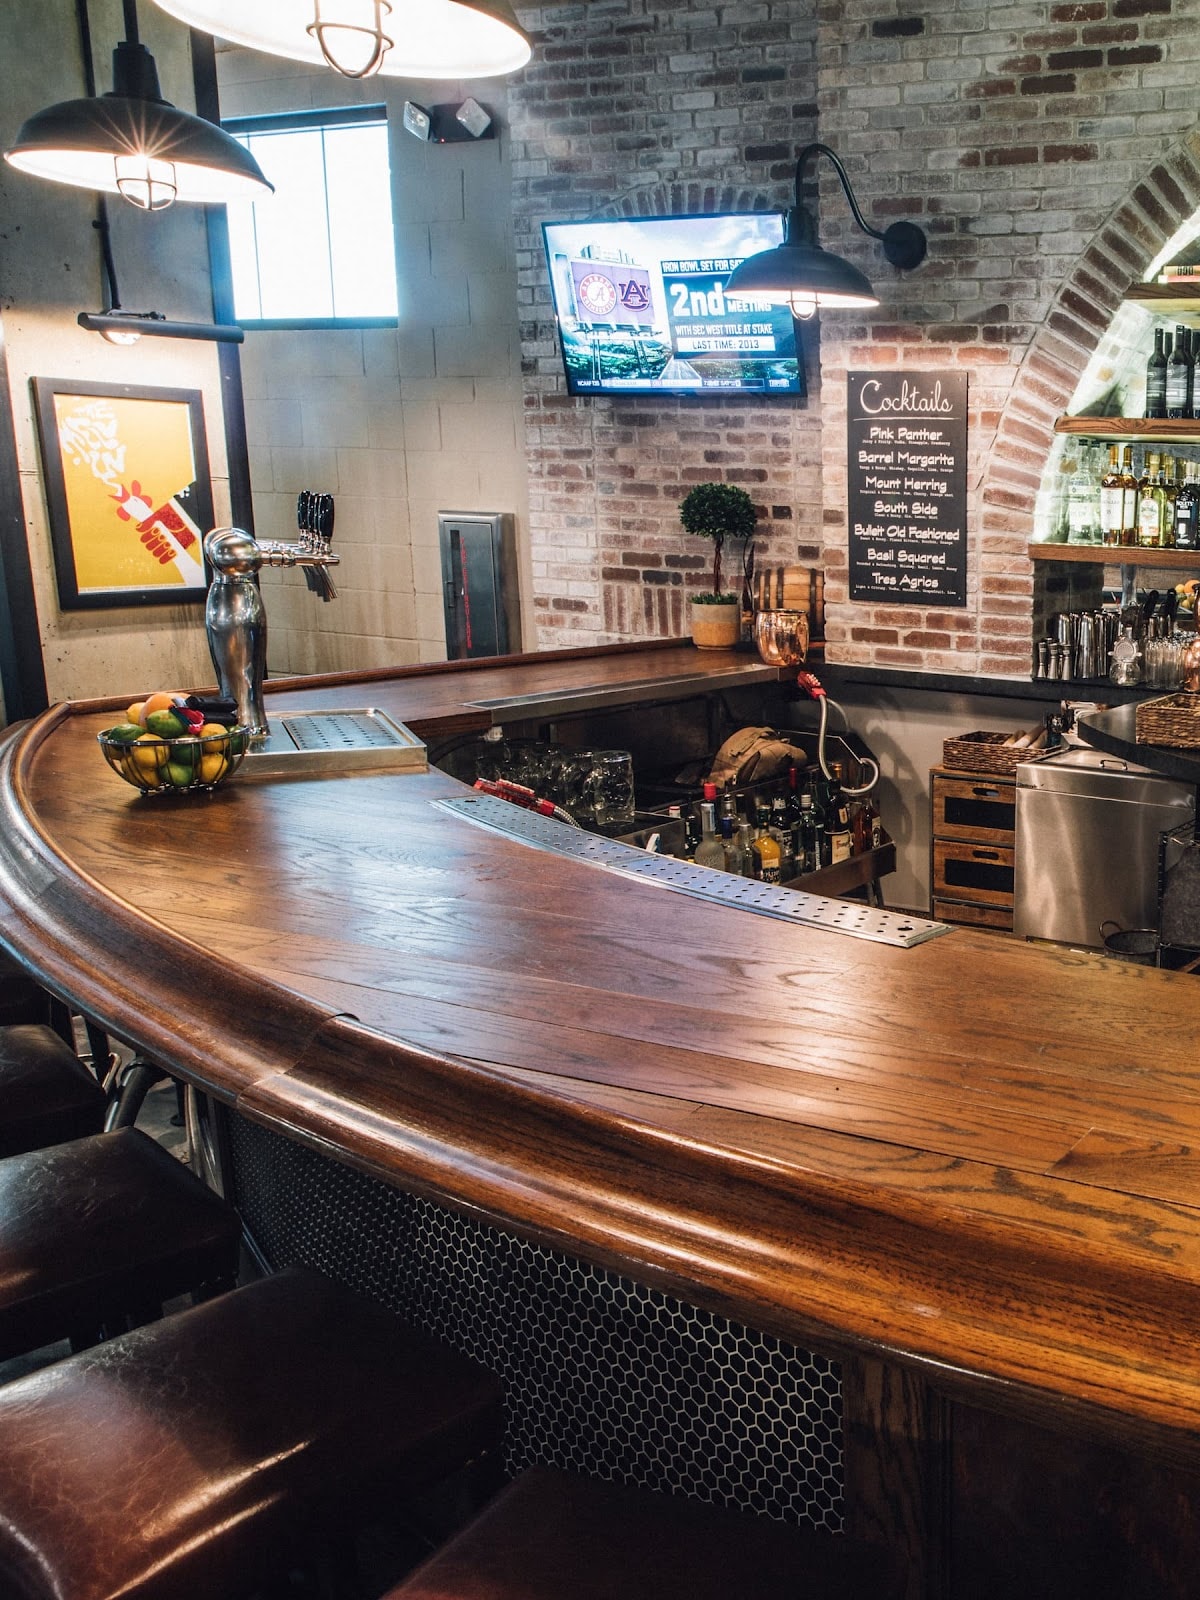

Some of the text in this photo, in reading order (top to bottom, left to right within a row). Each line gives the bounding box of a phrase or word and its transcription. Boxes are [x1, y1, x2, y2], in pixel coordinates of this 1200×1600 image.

[662, 261, 679, 272] IRON
[680, 260, 700, 272] BOWL
[700, 260, 714, 272] SET
[714, 260, 729, 271] FOR
[669, 281, 726, 317] 2nd
[727, 299, 772, 313] MEETING
[675, 323, 773, 335] WITH SEC WEST TITLE AT STAKE
[692, 339, 760, 350] LAST TIME: 2013
[860, 379, 953, 414] Cocktails
[869, 427, 943, 442] Pink Panther
[858, 451, 955, 467] Barrel Margarita
[865, 476, 947, 494] Mount Herring
[874, 500, 939, 515] South Side
[854, 524, 885, 537] Bulleit
[886, 525, 906, 538] Old
[908, 525, 960, 541] Fashioned
[867, 548, 946, 565] Basil Squared
[871, 572, 939, 589] Tres Agrios
